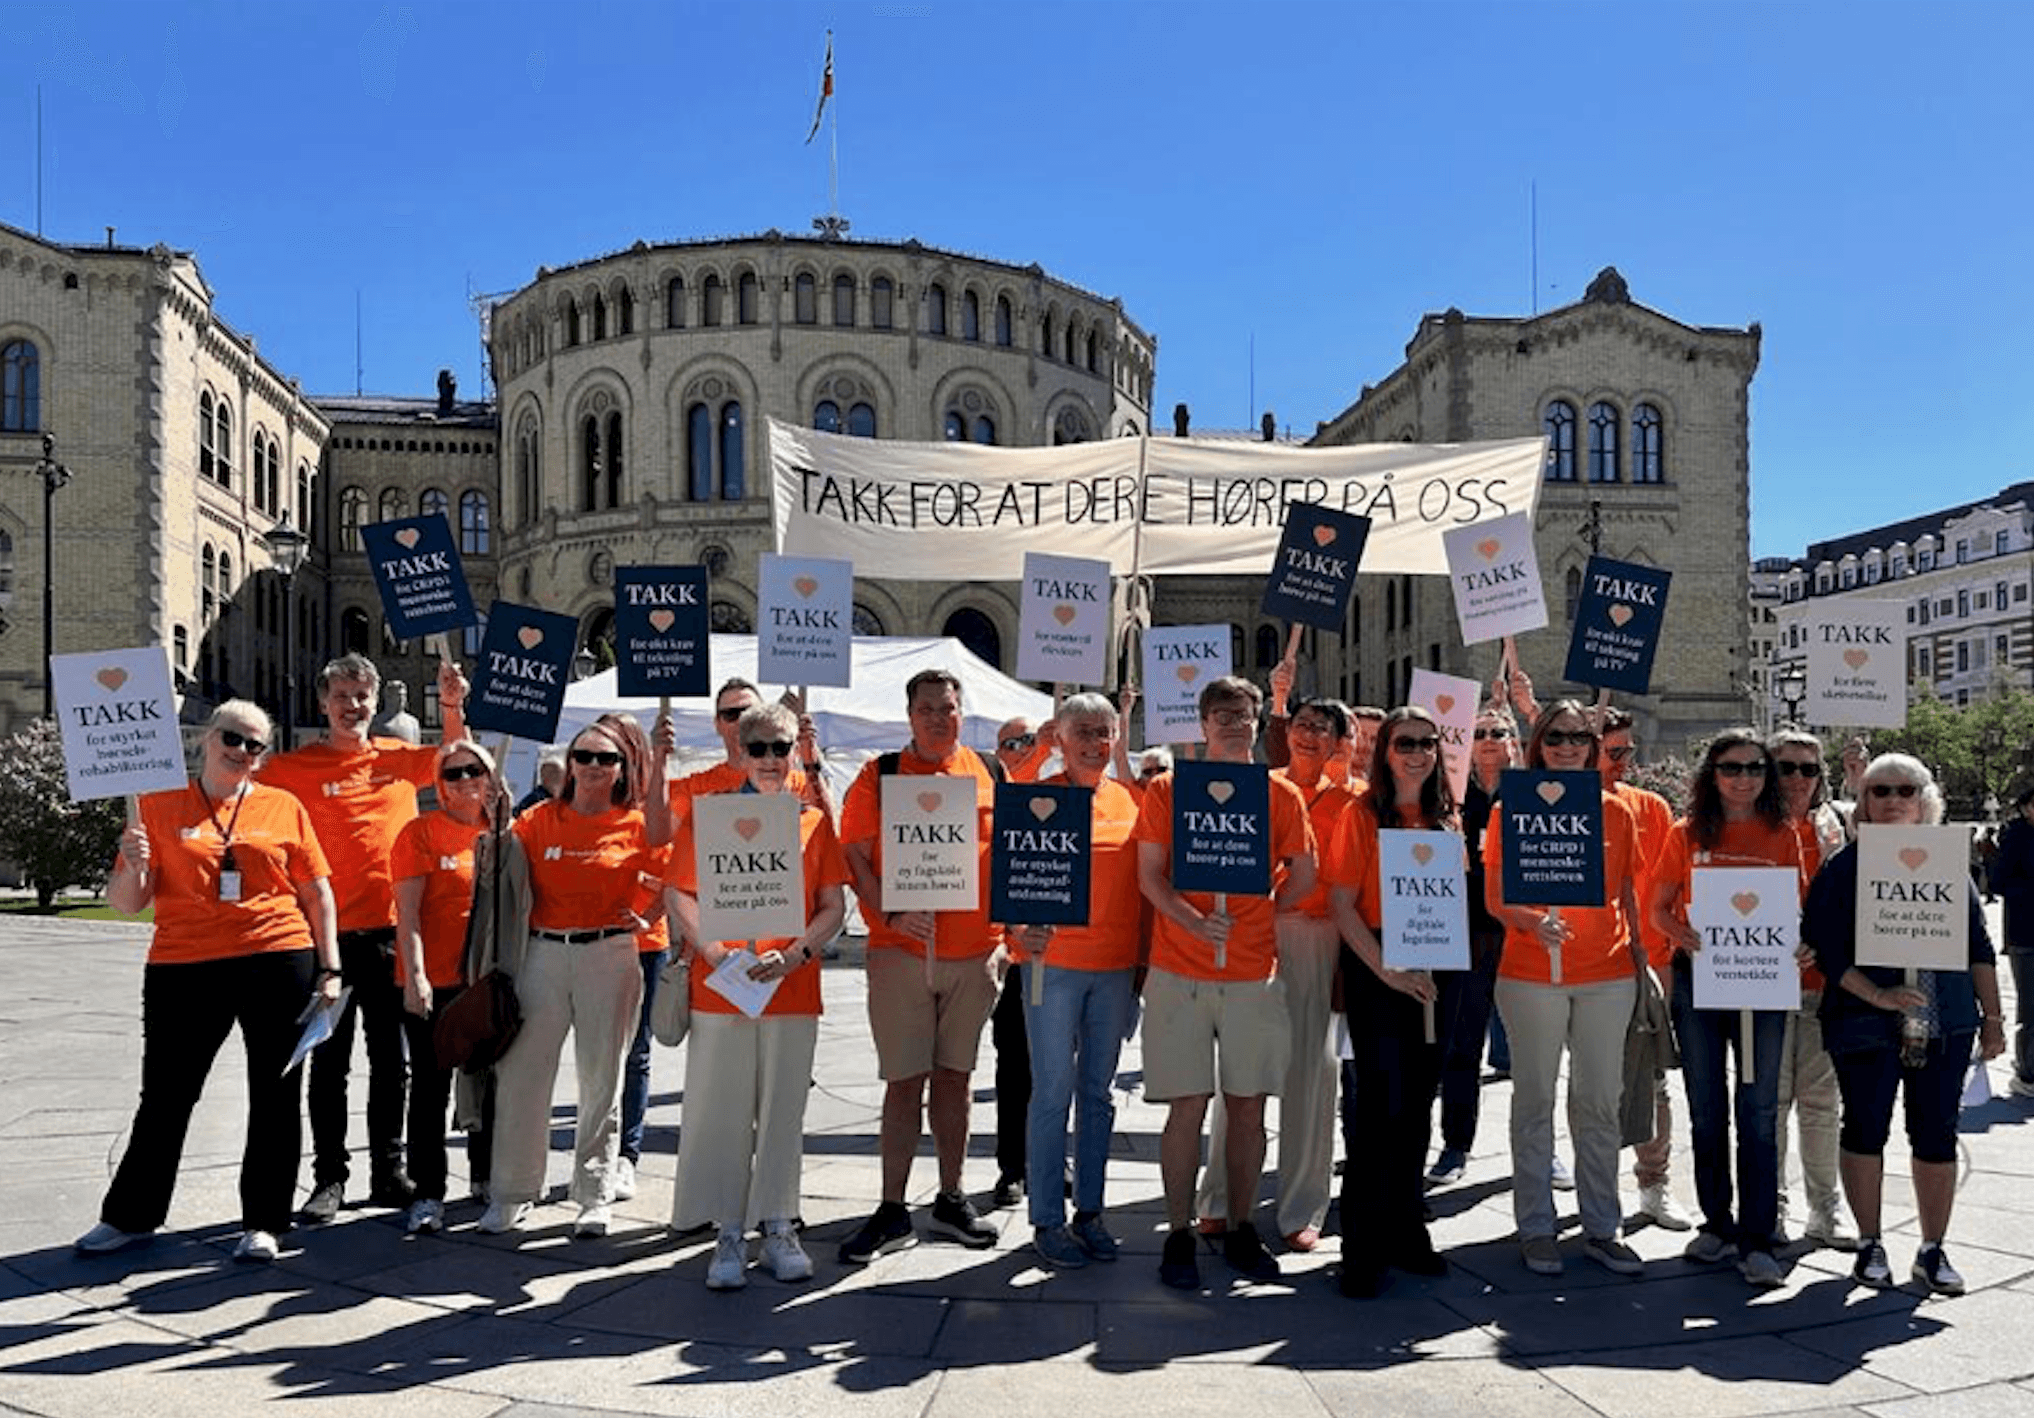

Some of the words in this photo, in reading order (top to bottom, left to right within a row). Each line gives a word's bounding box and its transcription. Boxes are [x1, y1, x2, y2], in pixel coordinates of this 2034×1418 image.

[791, 466, 897, 526] TAKK
[909, 482, 982, 528] FOR
[993, 482, 1053, 525] AT
[1065, 474, 1170, 524] DERE
[1343, 472, 1396, 521] PÅ
[1419, 478, 1507, 522] OSS
[382, 551, 450, 580] TAKK
[1287, 547, 1348, 579] TAKK
[1462, 561, 1527, 591] TAKK
[624, 584, 699, 605] TAKK
[1033, 578, 1097, 602] TAKK
[1594, 575, 1658, 605] TAKK
[770, 607, 838, 629] TAKK
[1819, 625, 1892, 643] TAKK
[1153, 642, 1219, 660] TAKK
[490, 651, 558, 685] TAKK
[647, 666, 661, 679] på
[662, 666, 679, 677] TV
[1610, 658, 1626, 670] TV
[73, 700, 162, 726] TAKK
[87, 734, 106, 746] for
[1440, 724, 1466, 745] KK
[893, 824, 965, 843] TAKK
[1184, 812, 1257, 835] TAKK
[1512, 814, 1591, 835] TAKK
[1003, 830, 1079, 854] TAKK
[1192, 837, 1209, 849] for
[1212, 841, 1223, 851] at
[1520, 840, 1539, 853] for
[709, 851, 789, 874] TAKK
[922, 851, 938, 861] for
[1010, 856, 1028, 869] for
[1221, 854, 1235, 867] på
[720, 883, 737, 892] for
[741, 884, 752, 892] at
[756, 881, 782, 892] dere
[1391, 876, 1456, 898] TAKK
[1871, 880, 1953, 904] TAKK
[751, 896, 765, 909] på
[770, 898, 789, 906] oss
[1879, 908, 1898, 920] for
[1901, 911, 1913, 920] at
[1917, 910, 1945, 922] dere
[1706, 925, 1785, 946] TAKK
[1912, 926, 1926, 937] på
[1931, 928, 1951, 937] oss
[1713, 954, 1731, 965] for
[1734, 954, 1779, 965] kortere
[1714, 969, 1778, 980] ventetider
